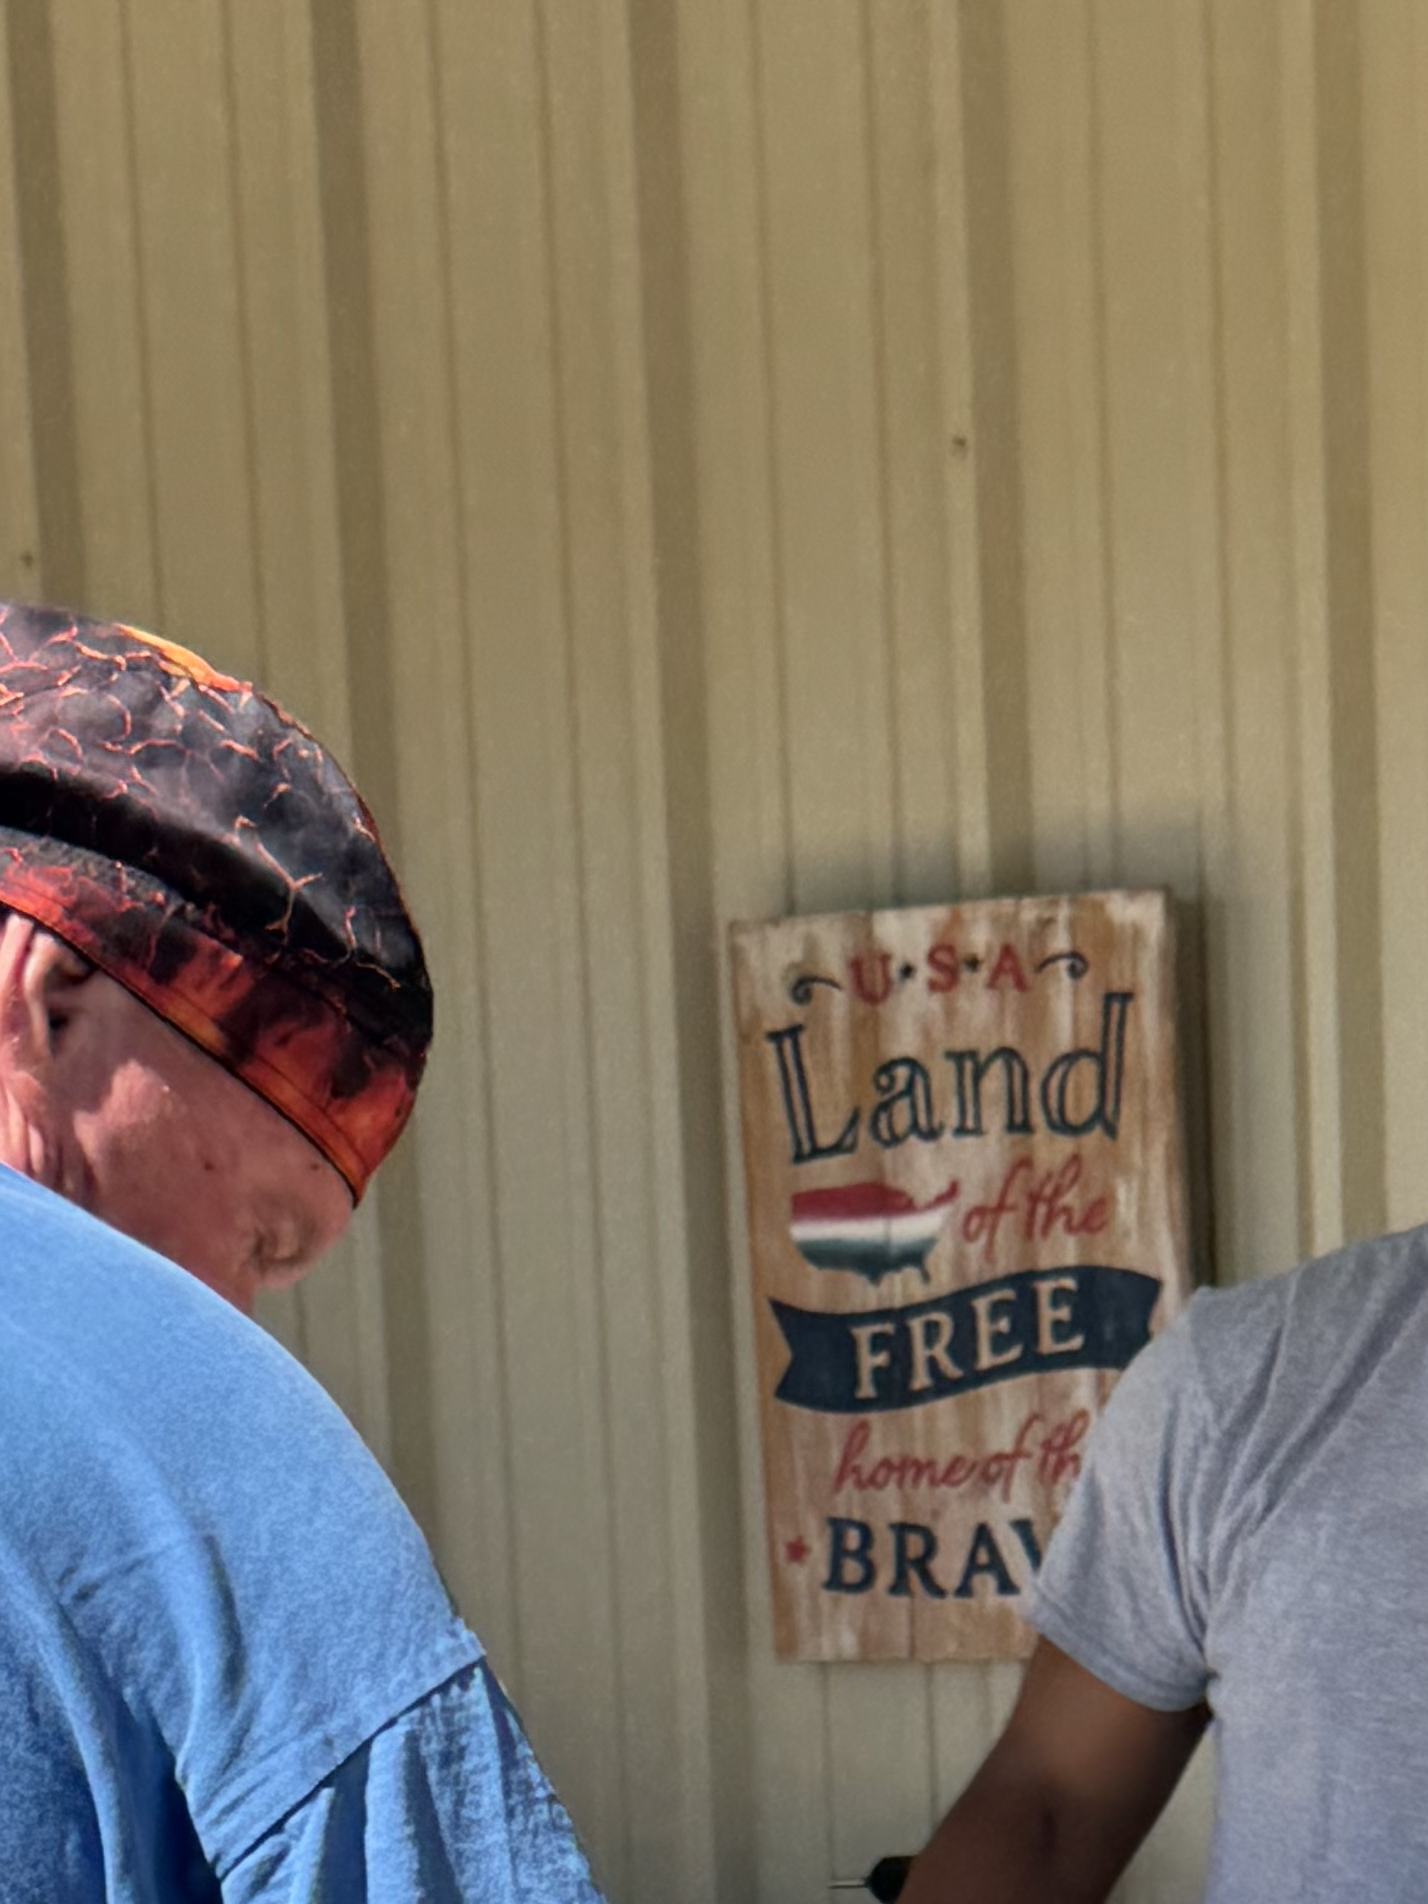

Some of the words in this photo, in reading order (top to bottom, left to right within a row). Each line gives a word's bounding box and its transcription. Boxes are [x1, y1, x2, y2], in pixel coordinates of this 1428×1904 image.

[766, 992, 1135, 1165] Land
[961, 1157, 1025, 1264] of
[1022, 1153, 1109, 1240] the
[851, 1276, 1085, 1399] FREE
[834, 1420, 974, 1496] home
[978, 1412, 1040, 1504] of
